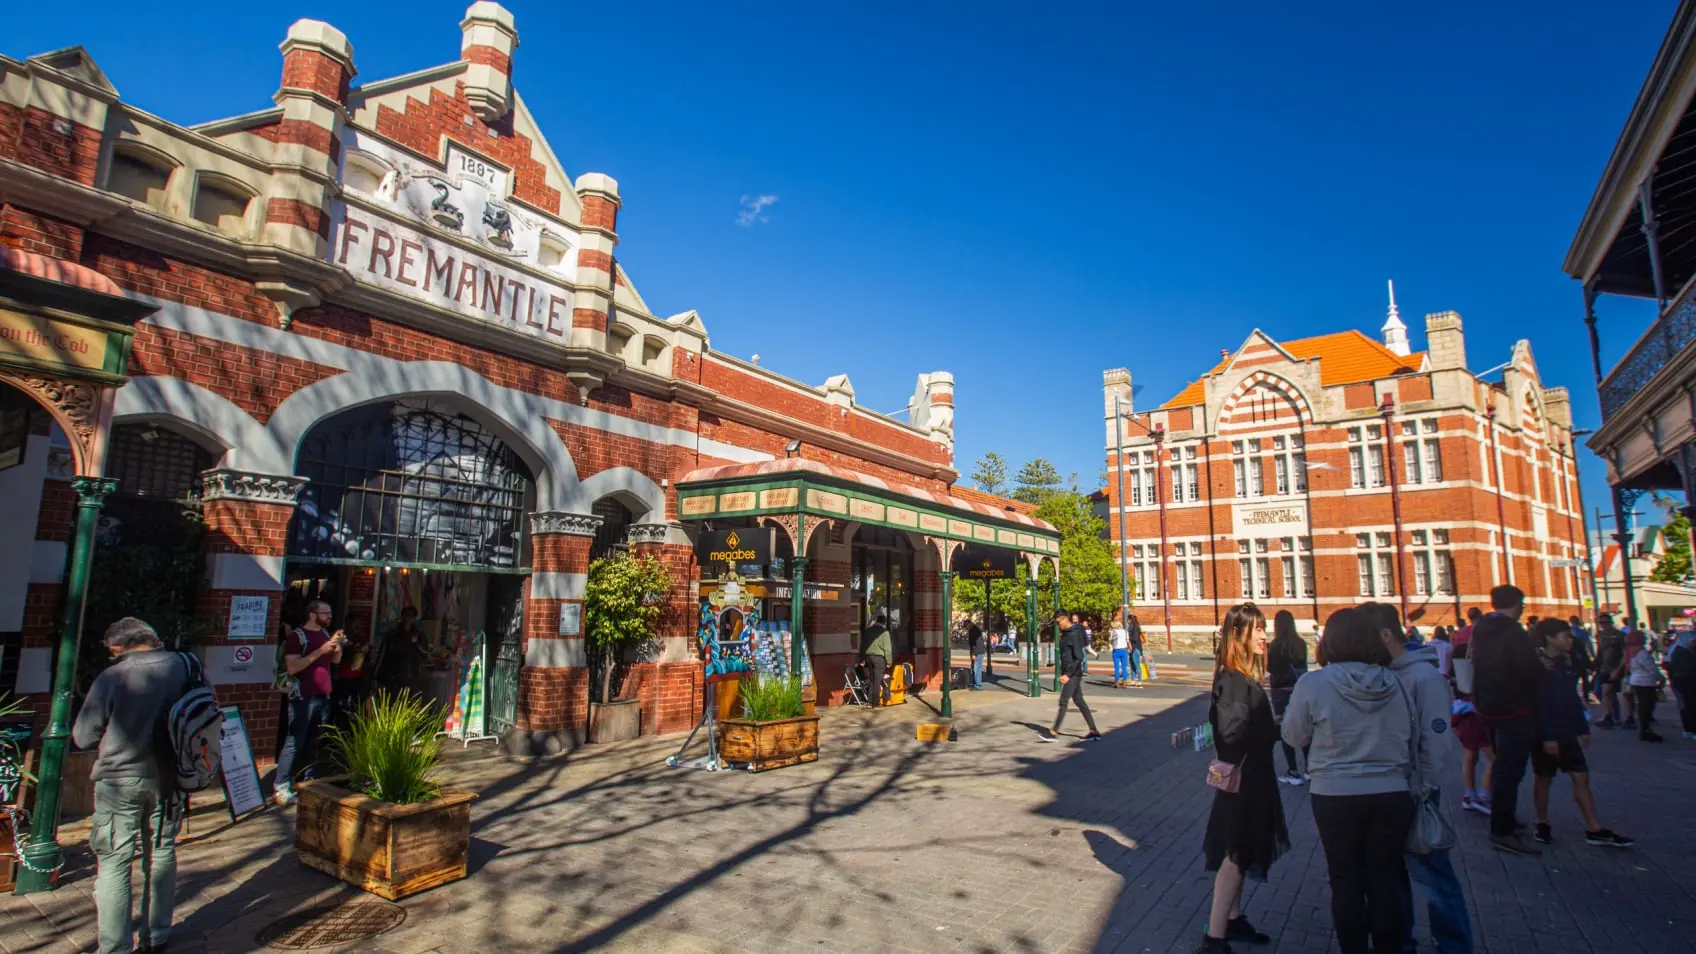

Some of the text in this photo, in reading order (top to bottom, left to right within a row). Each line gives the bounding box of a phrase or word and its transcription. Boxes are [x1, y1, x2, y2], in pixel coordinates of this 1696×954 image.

[460, 156, 496, 183] 1897
[338, 217, 566, 337] FREMANTLE
[25, 328, 48, 346] the
[54, 334, 89, 354] Cob
[1243, 515, 1302, 526] TECHNICAL SCHOOL
[1252, 509, 1291, 520] FREMANTLE
[710, 549, 756, 562] megabes
[969, 569, 1005, 578] megabes
[776, 587, 822, 600] INFOATION
